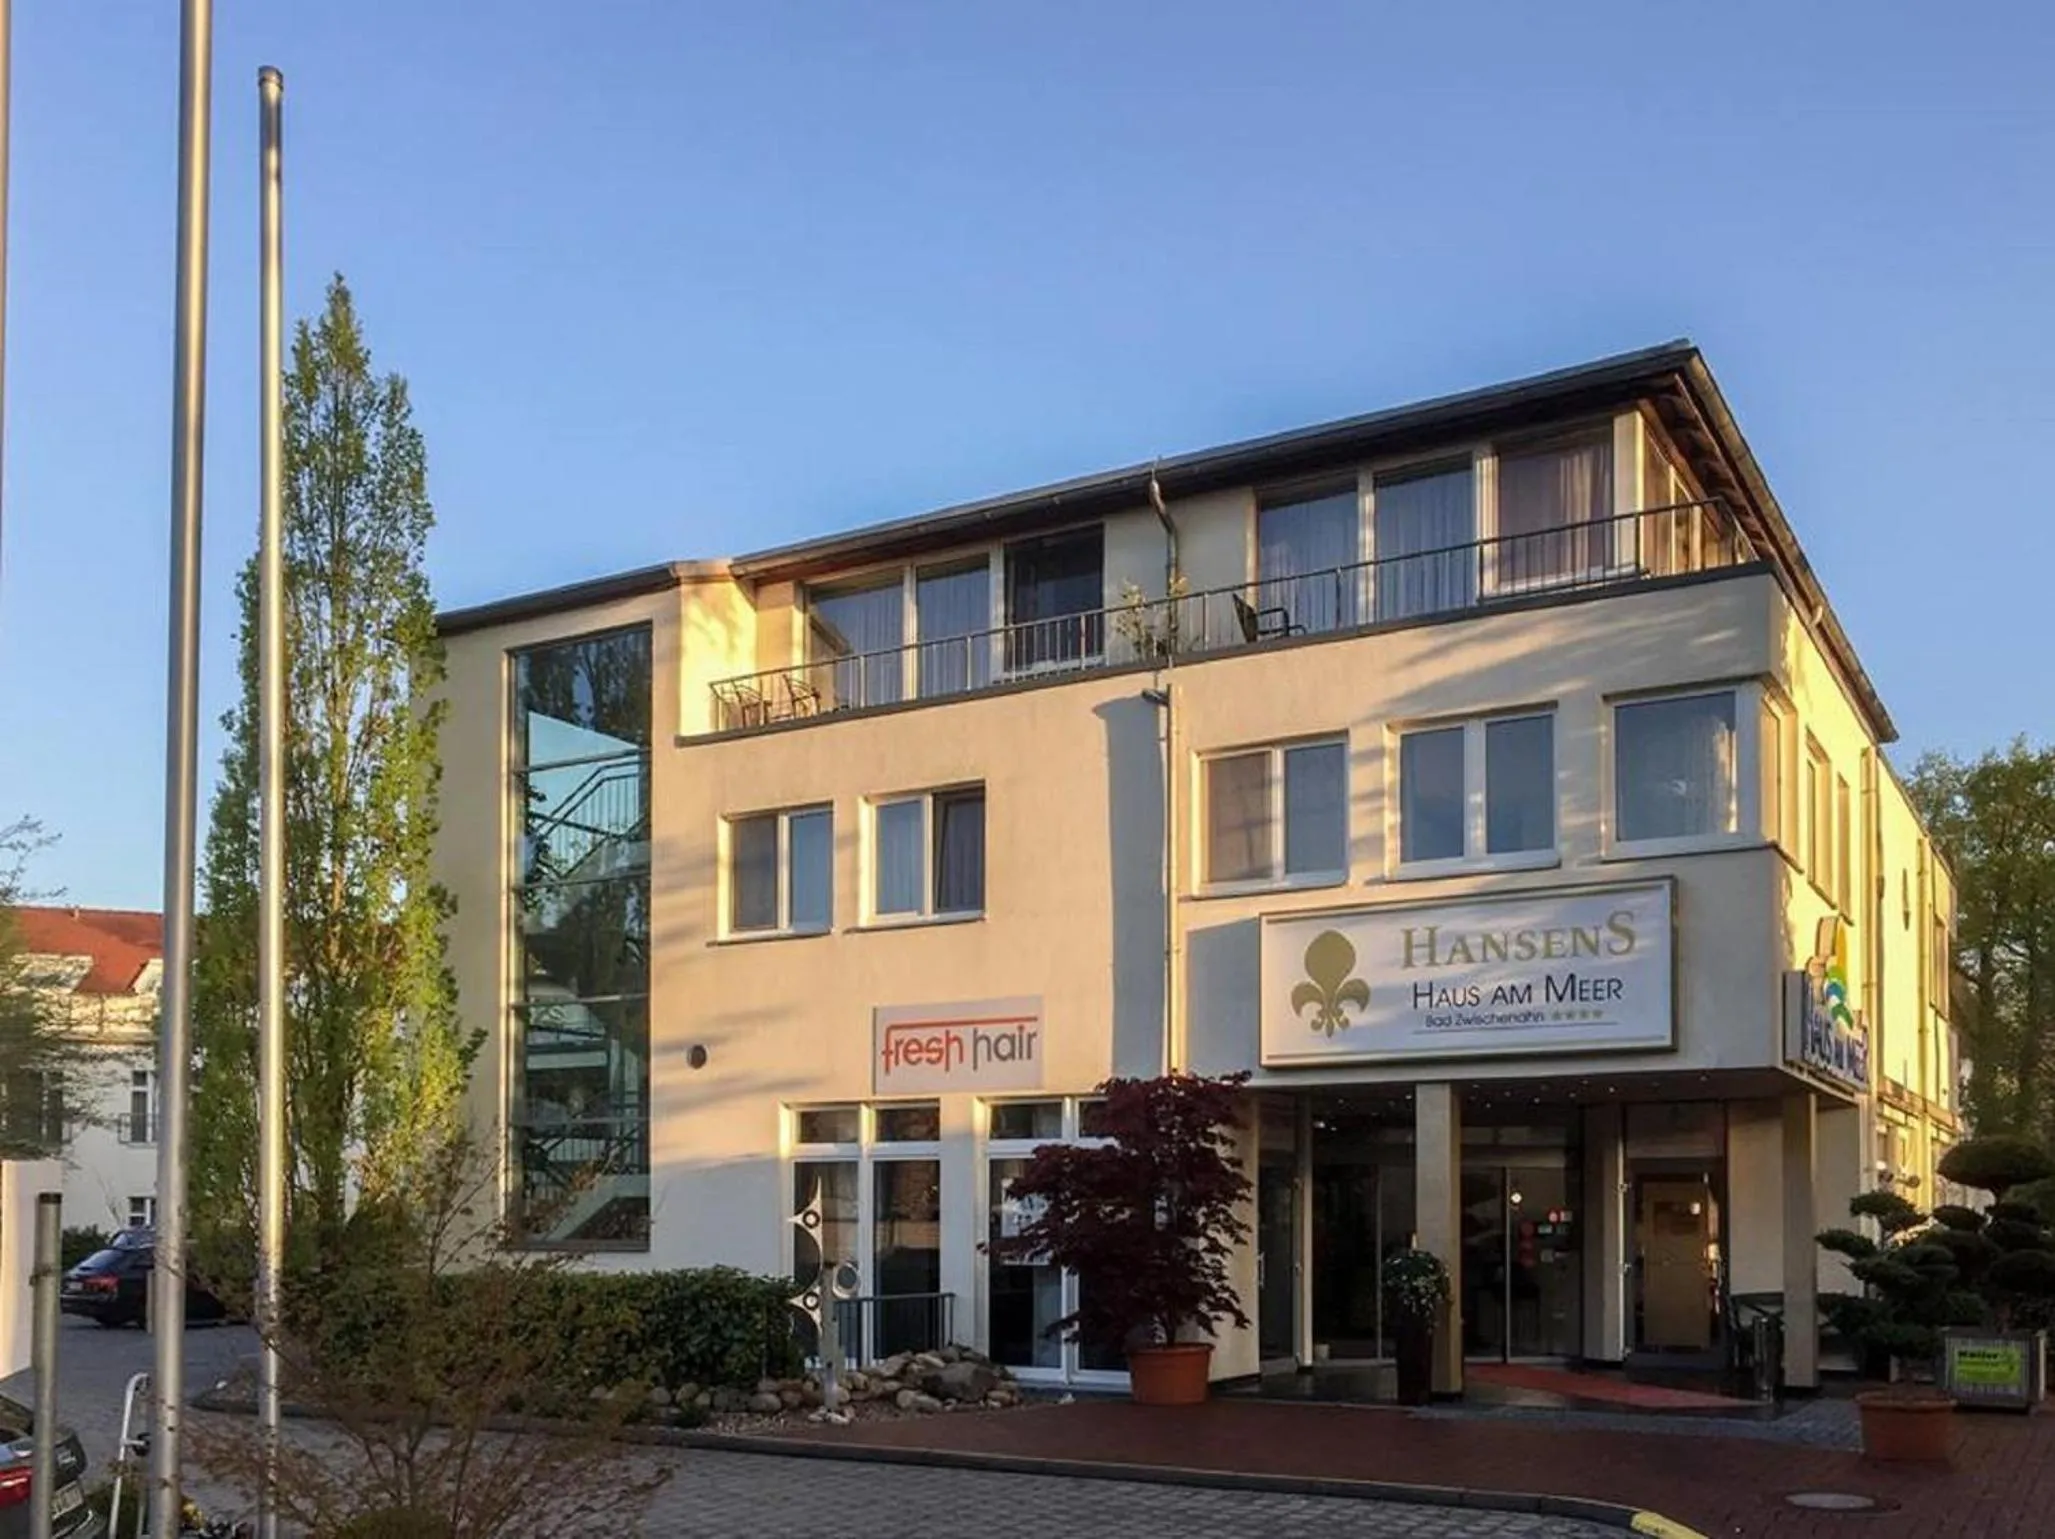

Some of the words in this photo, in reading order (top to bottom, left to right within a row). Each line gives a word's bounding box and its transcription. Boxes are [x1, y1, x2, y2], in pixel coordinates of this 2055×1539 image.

[1401, 910, 1637, 969] HANSENS
[1412, 981, 1481, 1010] HAUS
[1490, 983, 1533, 1006] AM
[1545, 972, 1624, 1004] MEER
[1425, 1012, 1453, 1028] Bad
[1455, 1009, 1546, 1027] Zwischenahn
[881, 1024, 965, 1075] fresh
[972, 1024, 1038, 1073] hair
